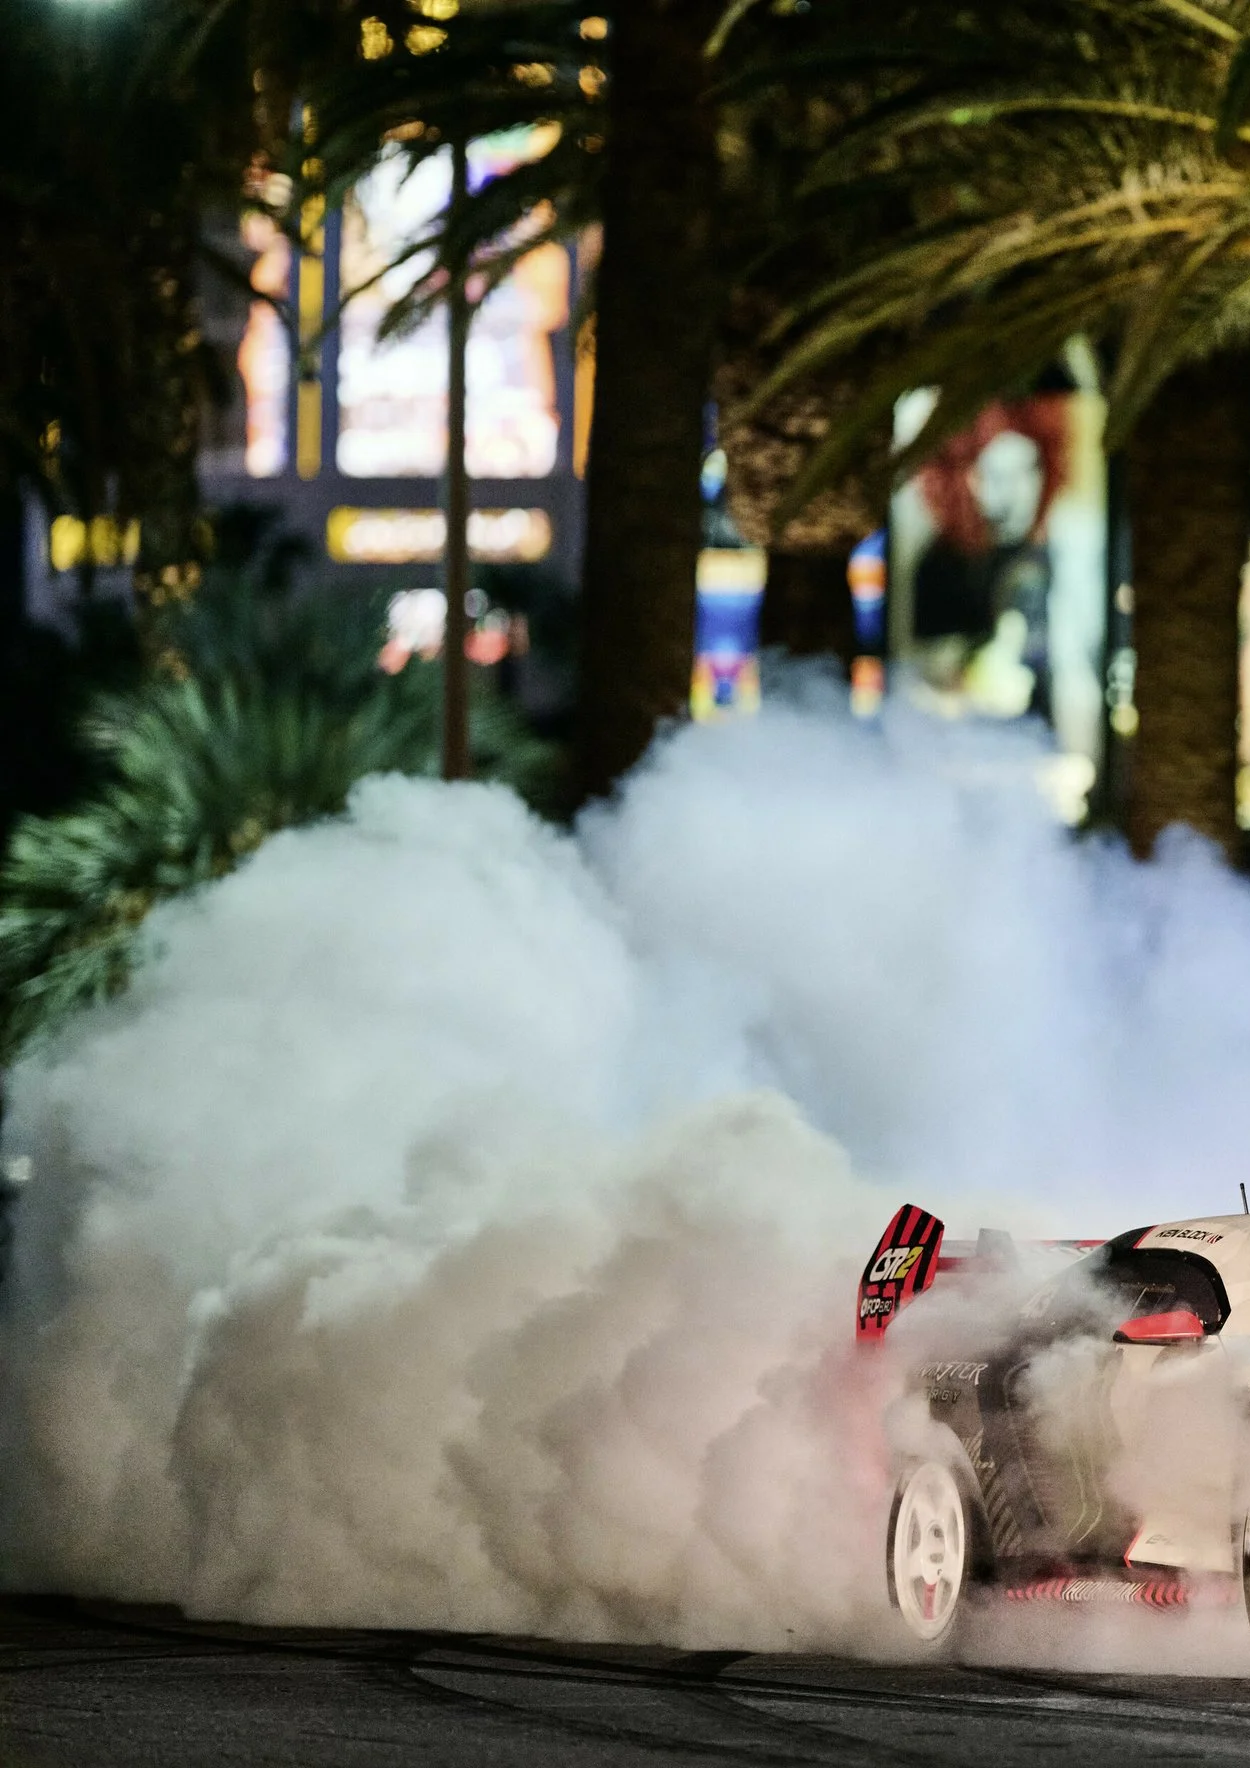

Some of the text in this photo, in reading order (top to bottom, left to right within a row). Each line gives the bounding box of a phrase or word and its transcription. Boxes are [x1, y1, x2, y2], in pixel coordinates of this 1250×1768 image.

[1155, 1229, 1212, 1242] KEN BLOCK
[869, 1246, 924, 1282] CSR2
